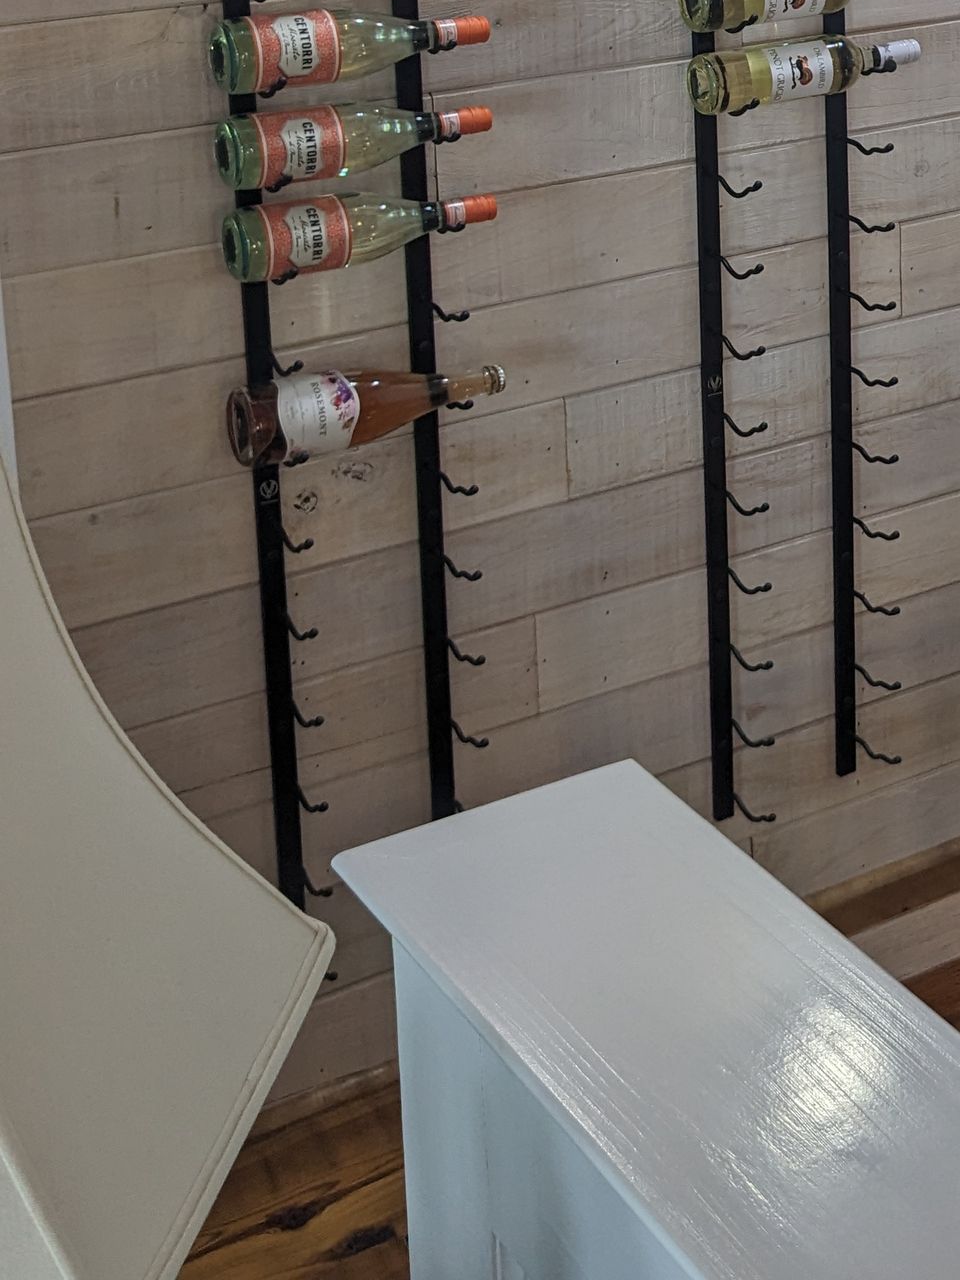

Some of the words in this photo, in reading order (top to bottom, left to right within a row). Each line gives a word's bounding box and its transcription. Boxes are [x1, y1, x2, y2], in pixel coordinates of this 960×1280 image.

[294, 17, 313, 69] CENTORRI
[769, 49, 784, 71] PINOT
[813, 48, 825, 89] DREAMBIRD
[302, 122, 316, 175] CENTORRI
[306, 208, 323, 261] CENTORRI
[310, 382, 327, 437] ROSEMONT
